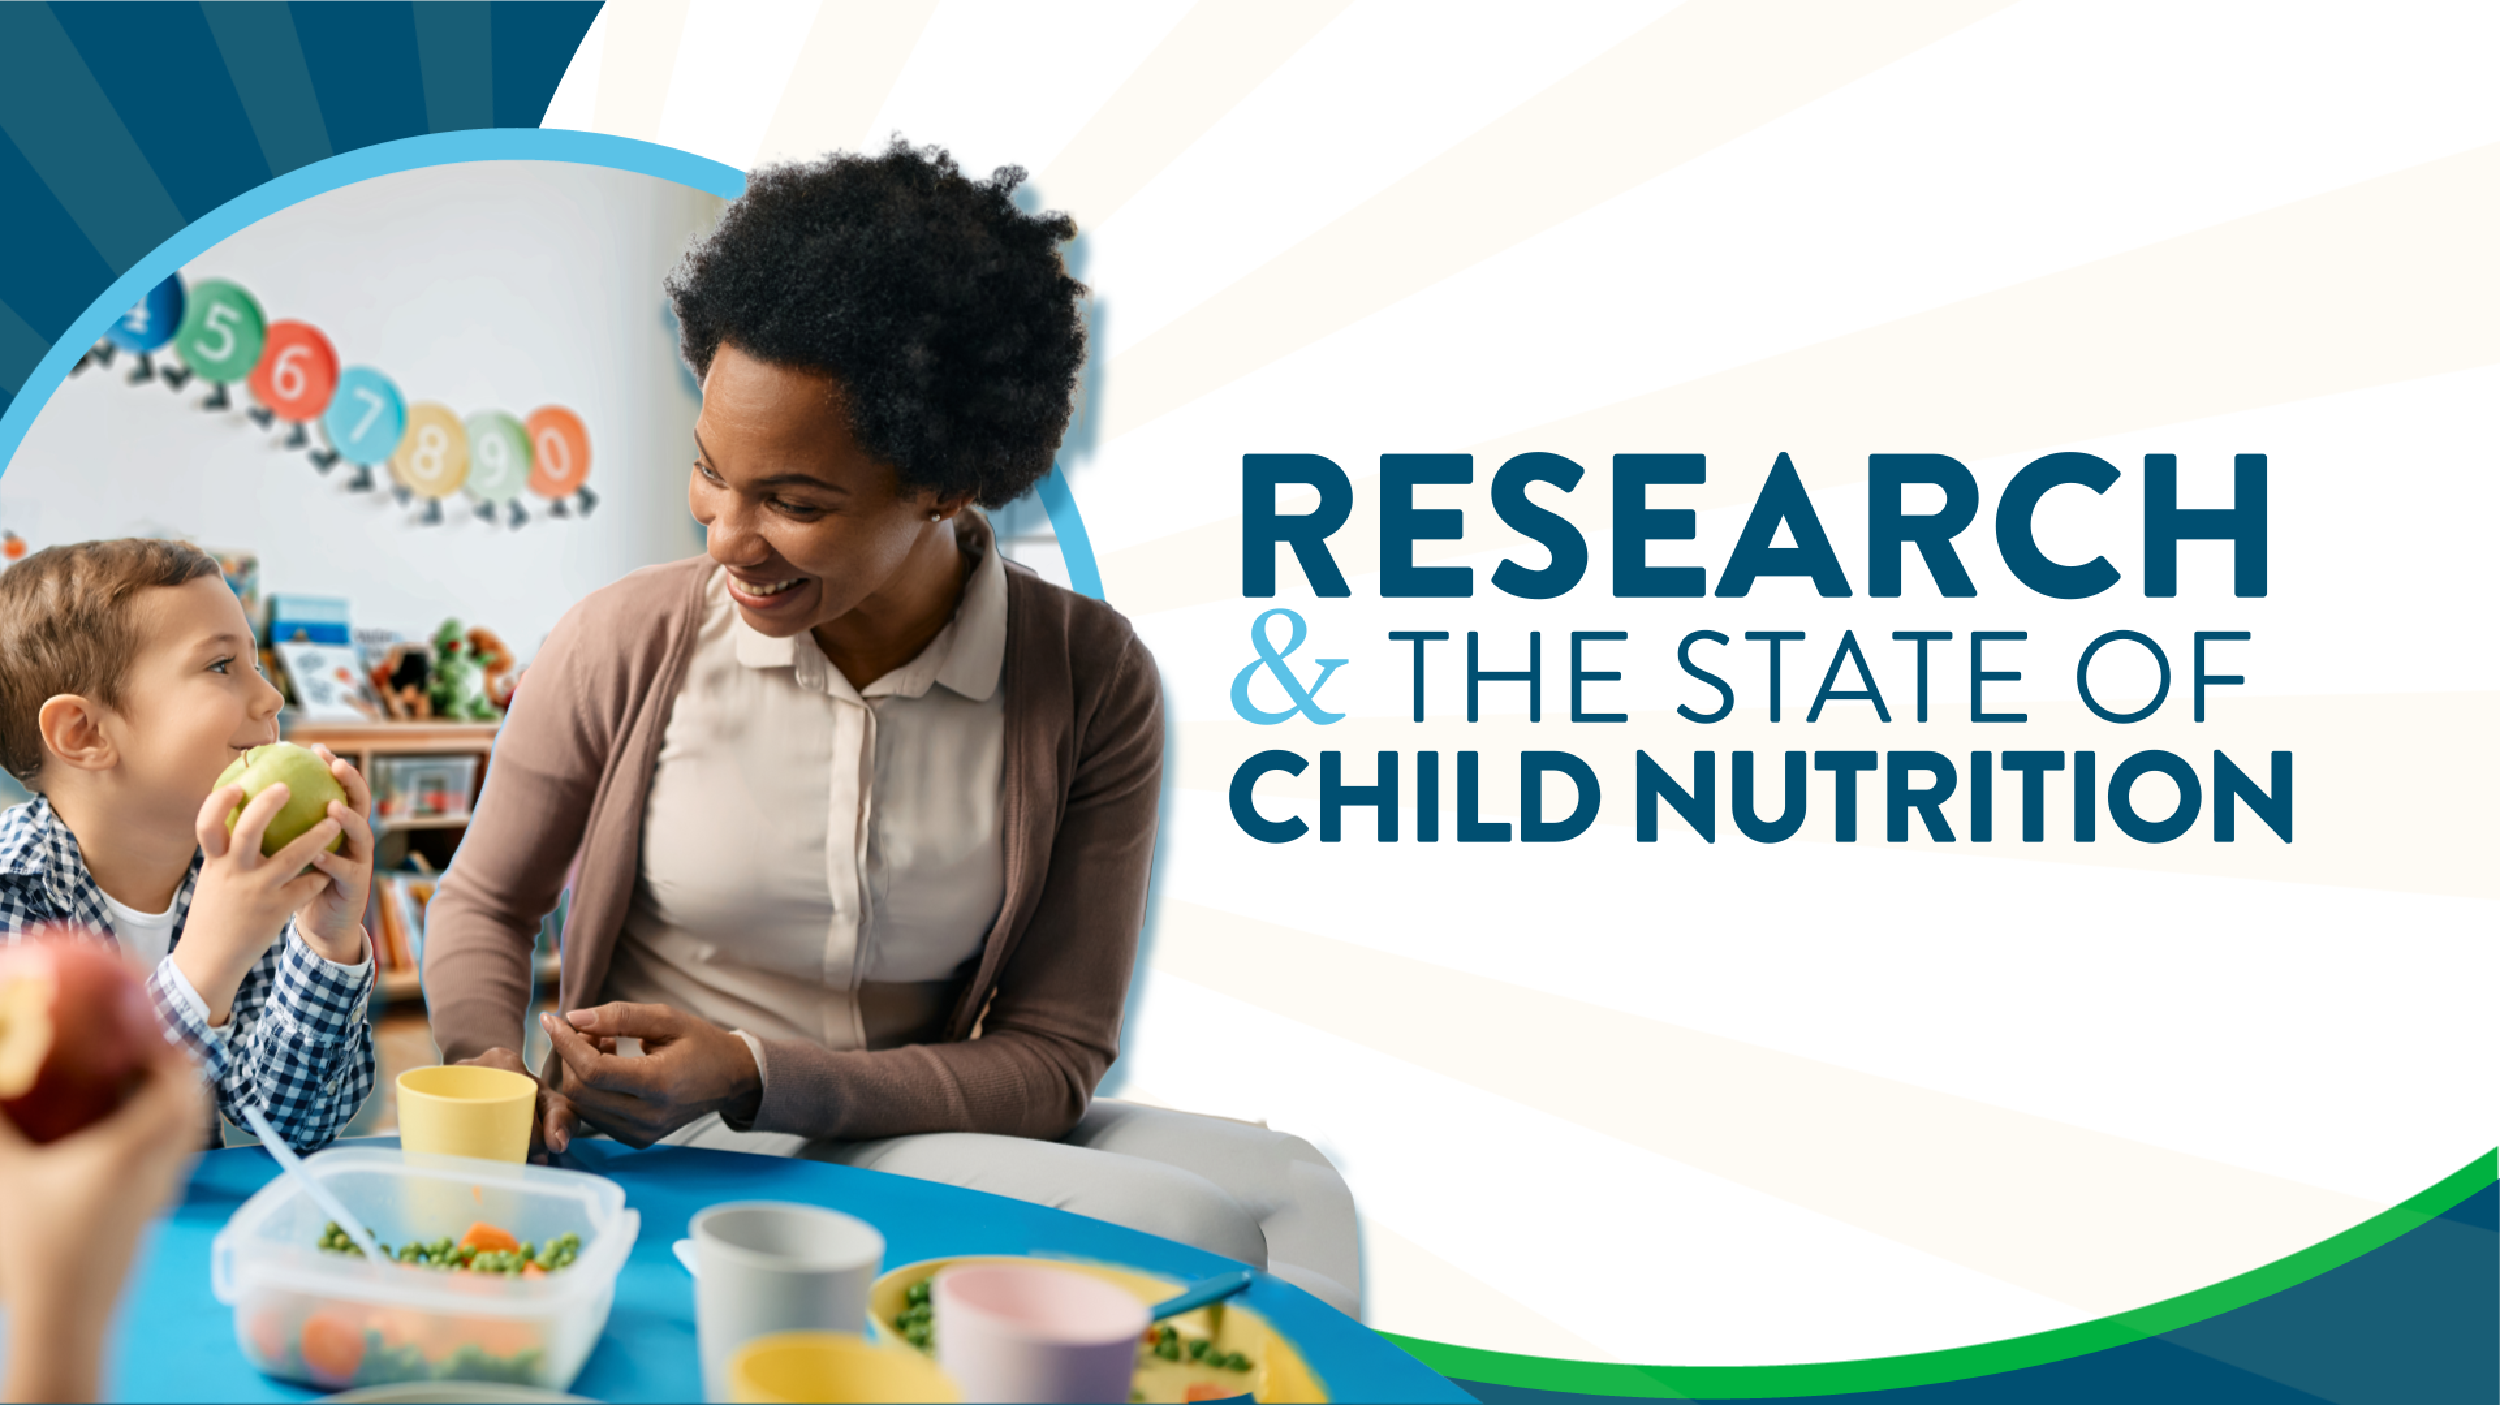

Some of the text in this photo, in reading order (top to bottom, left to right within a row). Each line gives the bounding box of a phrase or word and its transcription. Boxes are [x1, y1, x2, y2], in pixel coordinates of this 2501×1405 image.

[193, 301, 242, 362] 5
[272, 345, 312, 400] 6
[350, 386, 384, 443] 7
[410, 423, 448, 480] 8
[478, 432, 509, 488] 9
[538, 426, 571, 482] 0
